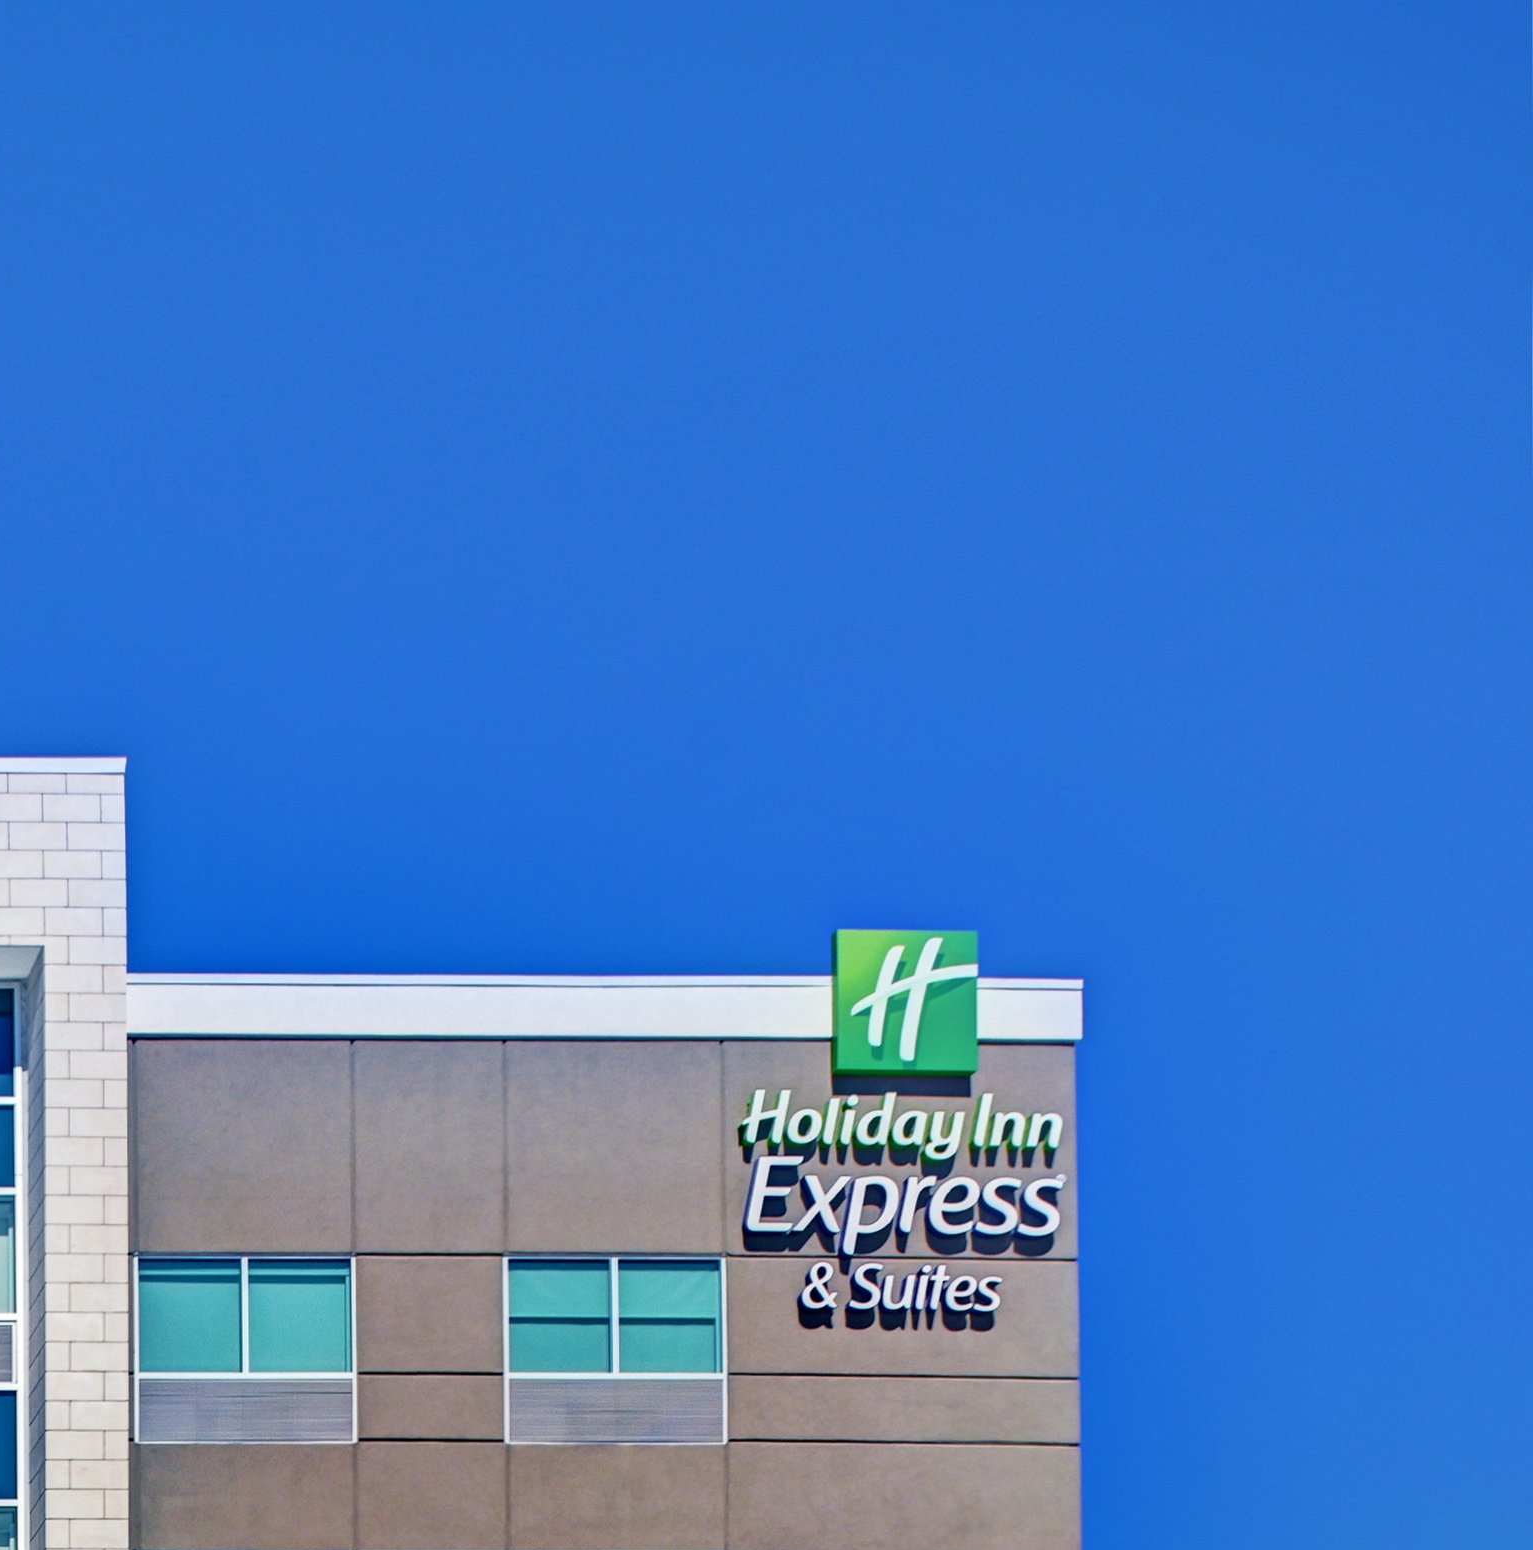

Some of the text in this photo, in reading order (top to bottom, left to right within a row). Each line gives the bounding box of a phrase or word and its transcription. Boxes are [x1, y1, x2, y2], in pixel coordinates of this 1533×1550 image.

[850, 937, 979, 1061] H
[740, 1089, 1064, 1160] Holiday Inn
[744, 1155, 1063, 1255] Express
[800, 1261, 1002, 1312] & Suites
